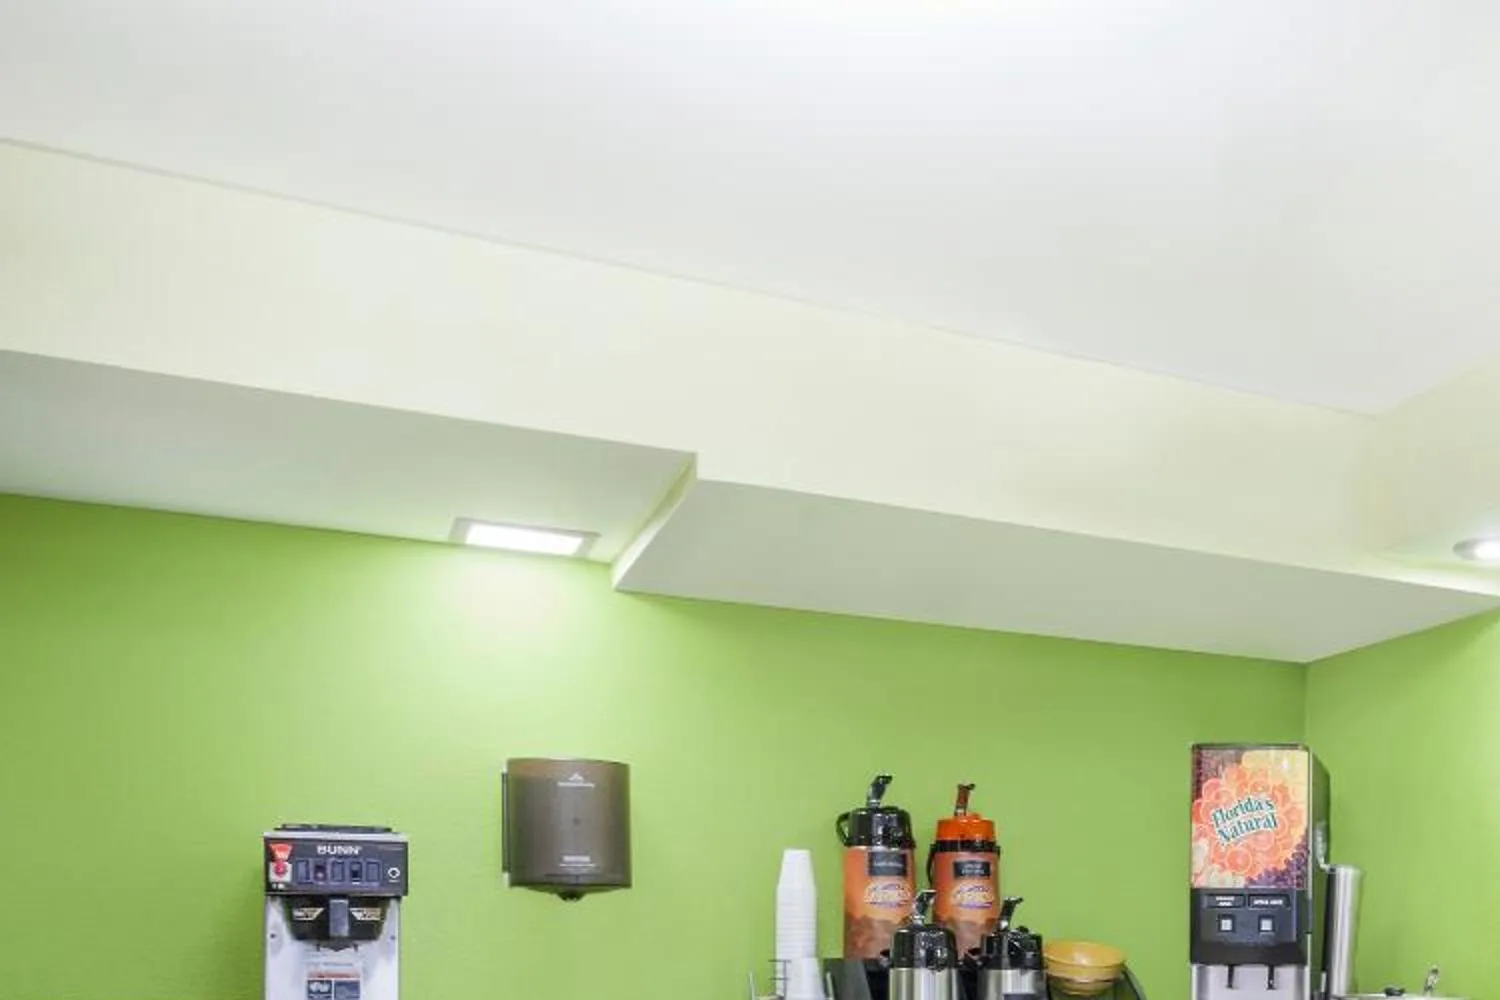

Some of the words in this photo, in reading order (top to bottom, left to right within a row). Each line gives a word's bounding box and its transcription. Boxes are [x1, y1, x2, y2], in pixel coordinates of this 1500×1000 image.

[1212, 797, 1275, 828] Florida's
[1217, 813, 1278, 845] Natural
[317, 845, 359, 855] BUNN
